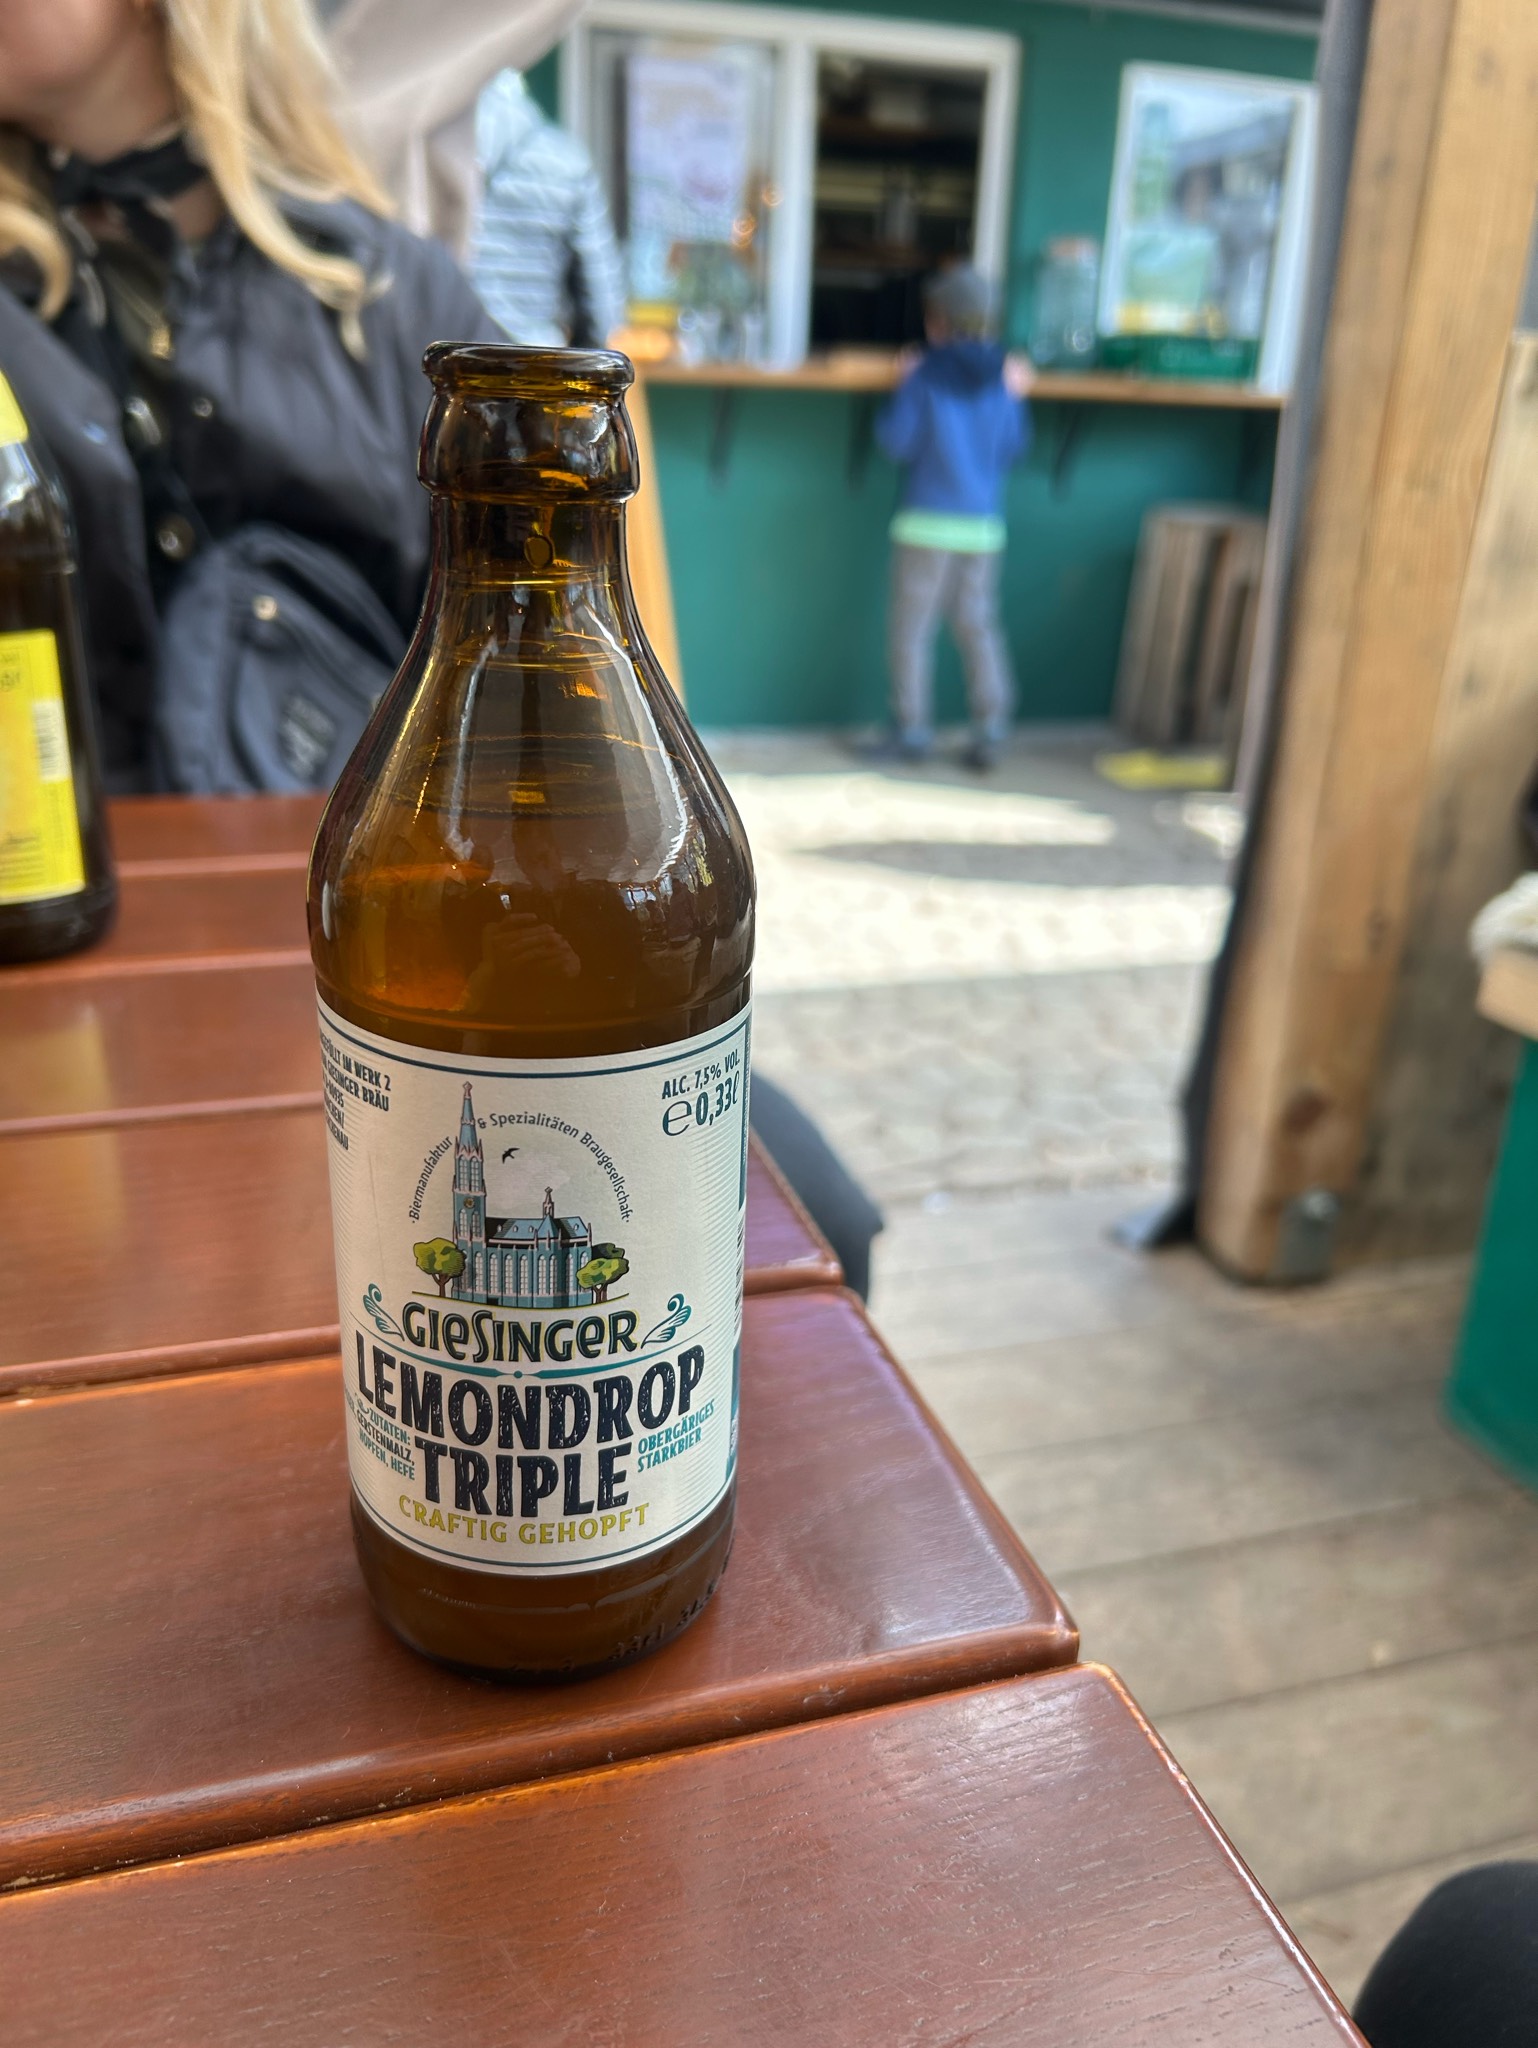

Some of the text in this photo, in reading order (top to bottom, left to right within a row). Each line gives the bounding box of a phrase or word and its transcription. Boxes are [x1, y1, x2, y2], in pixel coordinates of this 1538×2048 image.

[328, 1058, 360, 1099] GIESINGER
[362, 1084, 389, 1111] BRÄU
[342, 1053, 352, 1073] IM
[354, 1060, 382, 1088] WERK
[384, 1074, 392, 1091] 2
[662, 1075, 690, 1099] ALC.
[695, 1063, 721, 1090] 7,5%
[477, 1118, 487, 1129] &
[490, 1111, 579, 1139] Spezialitäten
[355, 1329, 705, 1450] LEMONDROP
[357, 1409, 415, 1466] GERSTENMALZ,
[369, 1406, 411, 1445] ZUTATEN:
[637, 1426, 702, 1473] STARKBIER
[638, 1398, 715, 1454] OBERGÄRIGES
[359, 1430, 415, 1480] HOPFEN, HEFE
[414, 1436, 632, 1518] TRIPLE
[399, 1495, 650, 1545] CRAFTIG GEHOPFT
